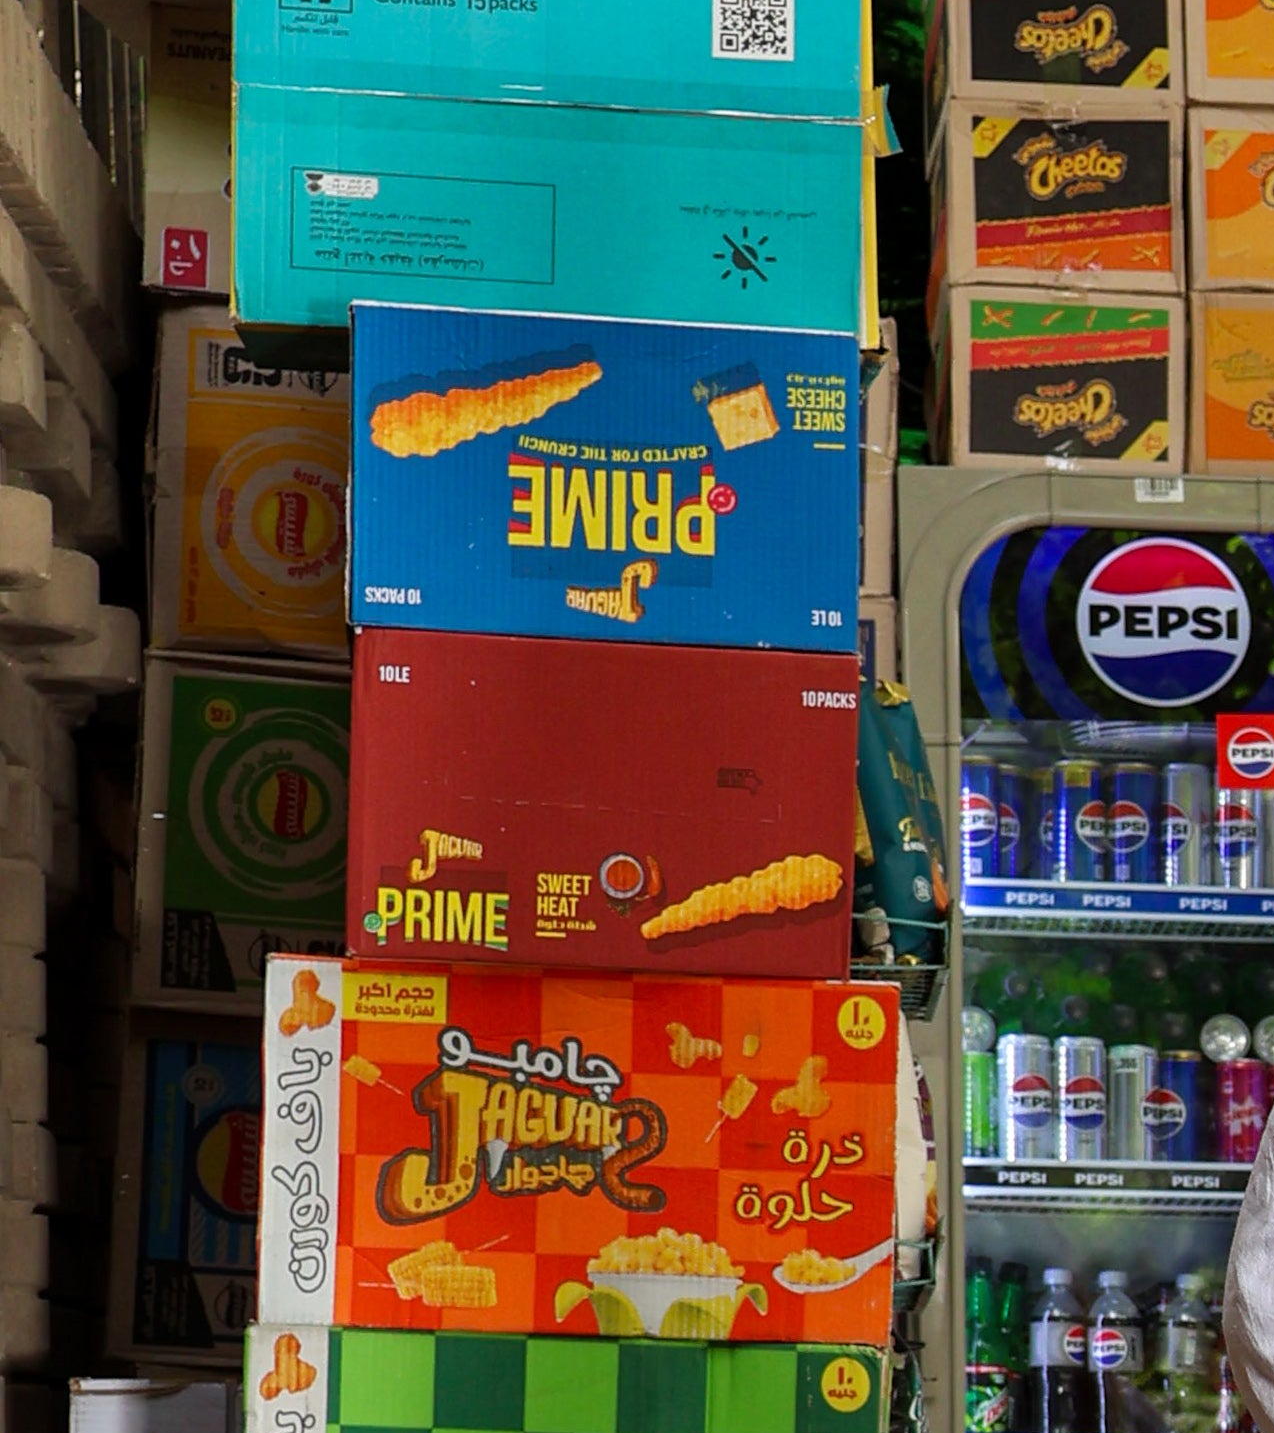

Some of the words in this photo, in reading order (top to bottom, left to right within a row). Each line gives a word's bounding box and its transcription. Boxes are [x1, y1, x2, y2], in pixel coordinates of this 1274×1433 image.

[1017, 4, 1115, 60] Cheetos
[787, 388, 846, 409] CHEESE
[793, 411, 846, 431] SWEET
[518, 435, 577, 459] CRUNCH
[643, 444, 708, 461] CRAFTED
[508, 464, 716, 557] PRIME
[365, 586, 405, 604] PACKS
[407, 589, 422, 605] 10
[1088, 604, 1240, 640] PEPSI
[815, 692, 857, 709] PACKS
[1232, 747, 1274, 761] PEPSI
[537, 873, 592, 896] SWEET
[537, 896, 577, 917] HEAT
[1005, 892, 1055, 906] PEPSI
[1082, 894, 1132, 909] PEPSI
[1179, 897, 1228, 912] PEPSI
[377, 887, 510, 952] PRIME
[398, 983, 435, 1003] حجم
[783, 1129, 865, 1178] ذرة
[997, 1171, 1047, 1185] PEPSI
[735, 1187, 854, 1231] حلوة
